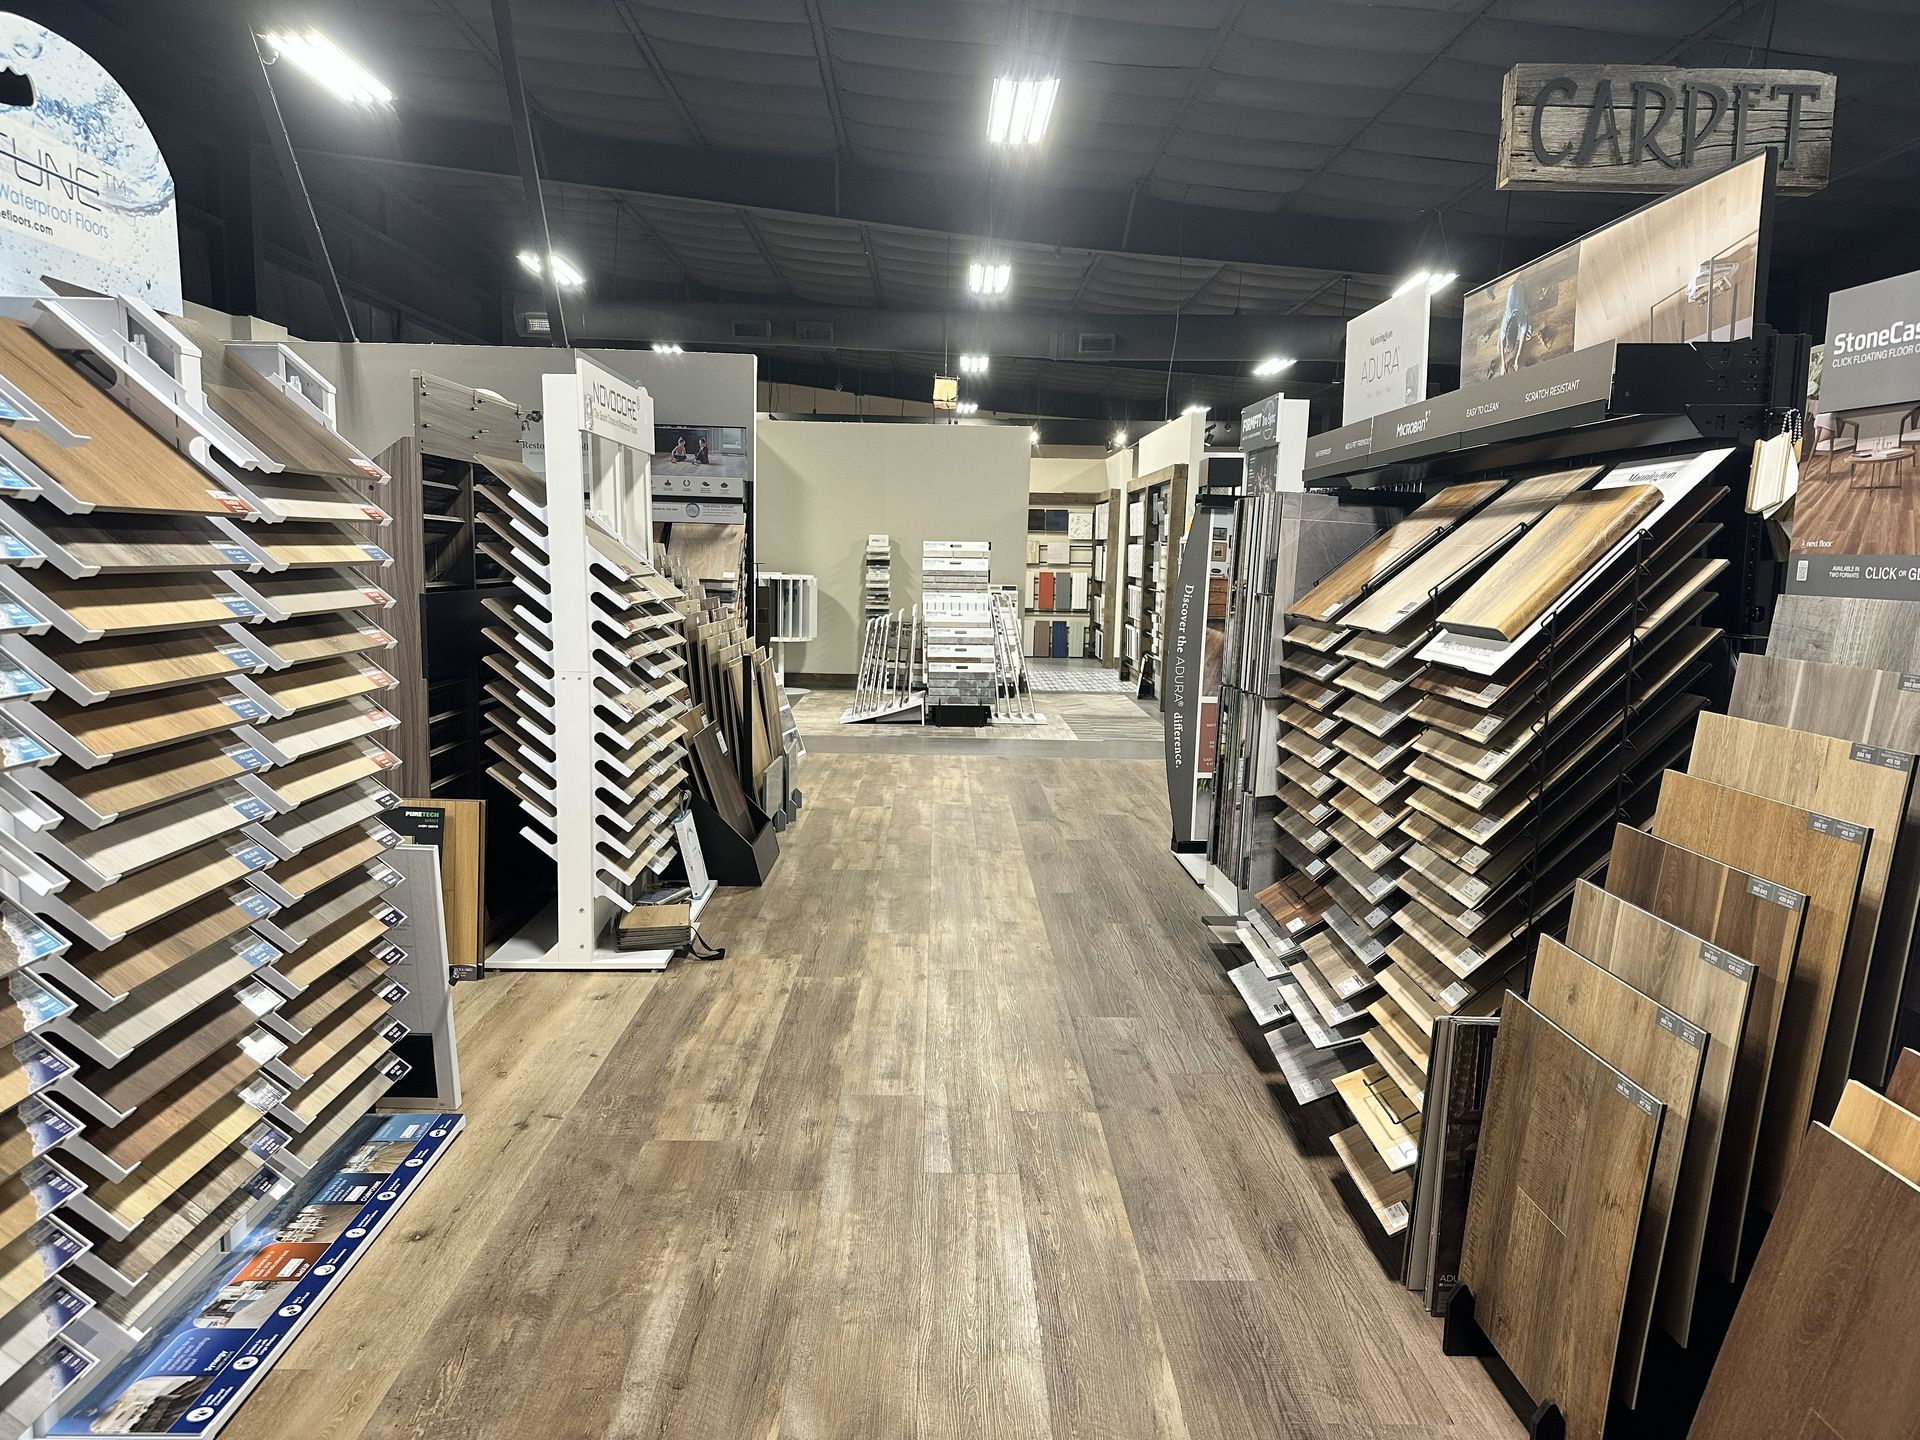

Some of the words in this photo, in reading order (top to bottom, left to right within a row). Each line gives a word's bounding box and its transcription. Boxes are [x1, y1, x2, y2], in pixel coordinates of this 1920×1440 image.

[1531, 76, 1821, 171] CARPET
[0, 182, 72, 224] Waterproof
[75, 211, 109, 239] Floors
[1832, 355, 1853, 368] CLICK
[1853, 350, 1888, 364] FLOATING
[1889, 344, 1914, 358] FLOOR
[1525, 387, 1549, 402] SCRATCH
[1550, 379, 1581, 396] RESISTANT
[1466, 407, 1477, 418] EASY
[1484, 401, 1500, 413] CLEAN
[1865, 567, 1898, 580] CLICK
[1178, 584, 1195, 633] Discover
[1176, 635, 1187, 653] the
[1173, 711, 1183, 768] difference.
